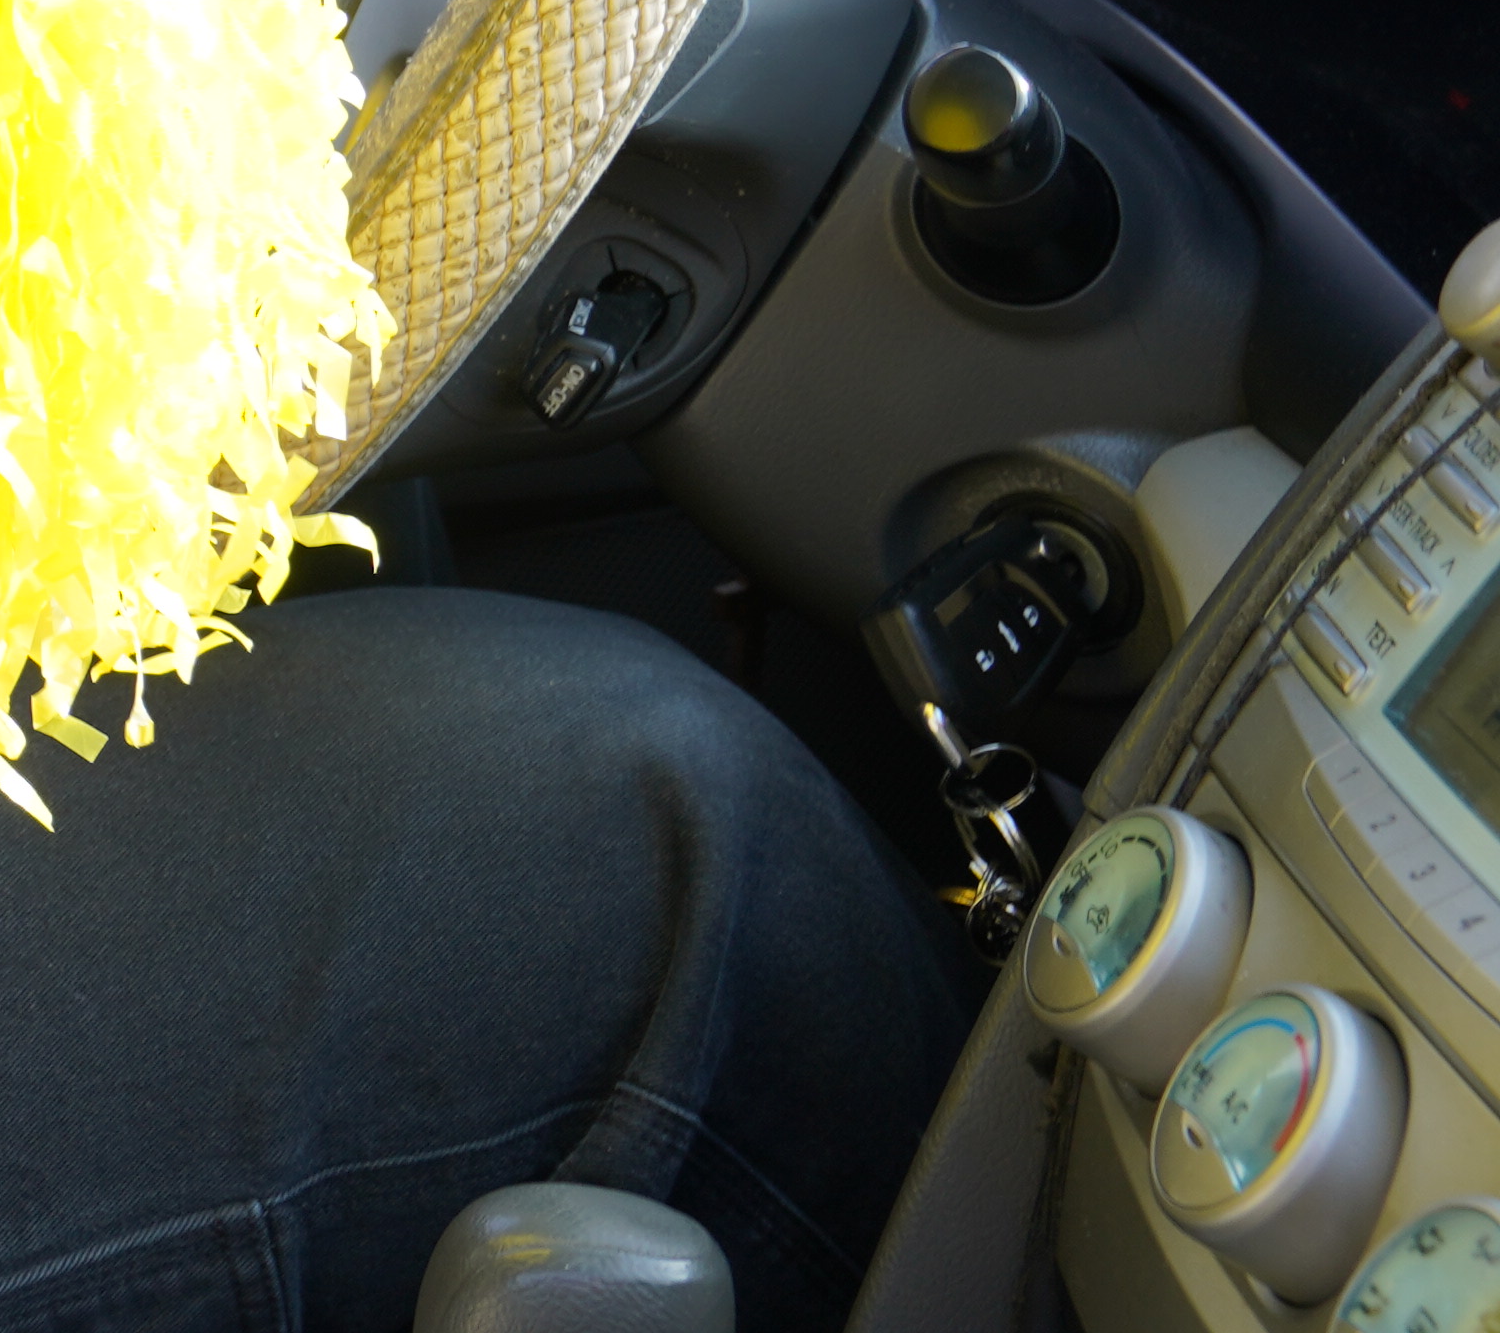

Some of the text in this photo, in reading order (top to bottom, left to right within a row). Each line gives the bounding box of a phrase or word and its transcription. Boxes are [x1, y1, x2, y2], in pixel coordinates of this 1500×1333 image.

[1367, 620, 1397, 659] TEXT
[1369, 813, 1397, 833] 2
[1408, 862, 1437, 883] 3
[1458, 913, 1487, 933] 4
